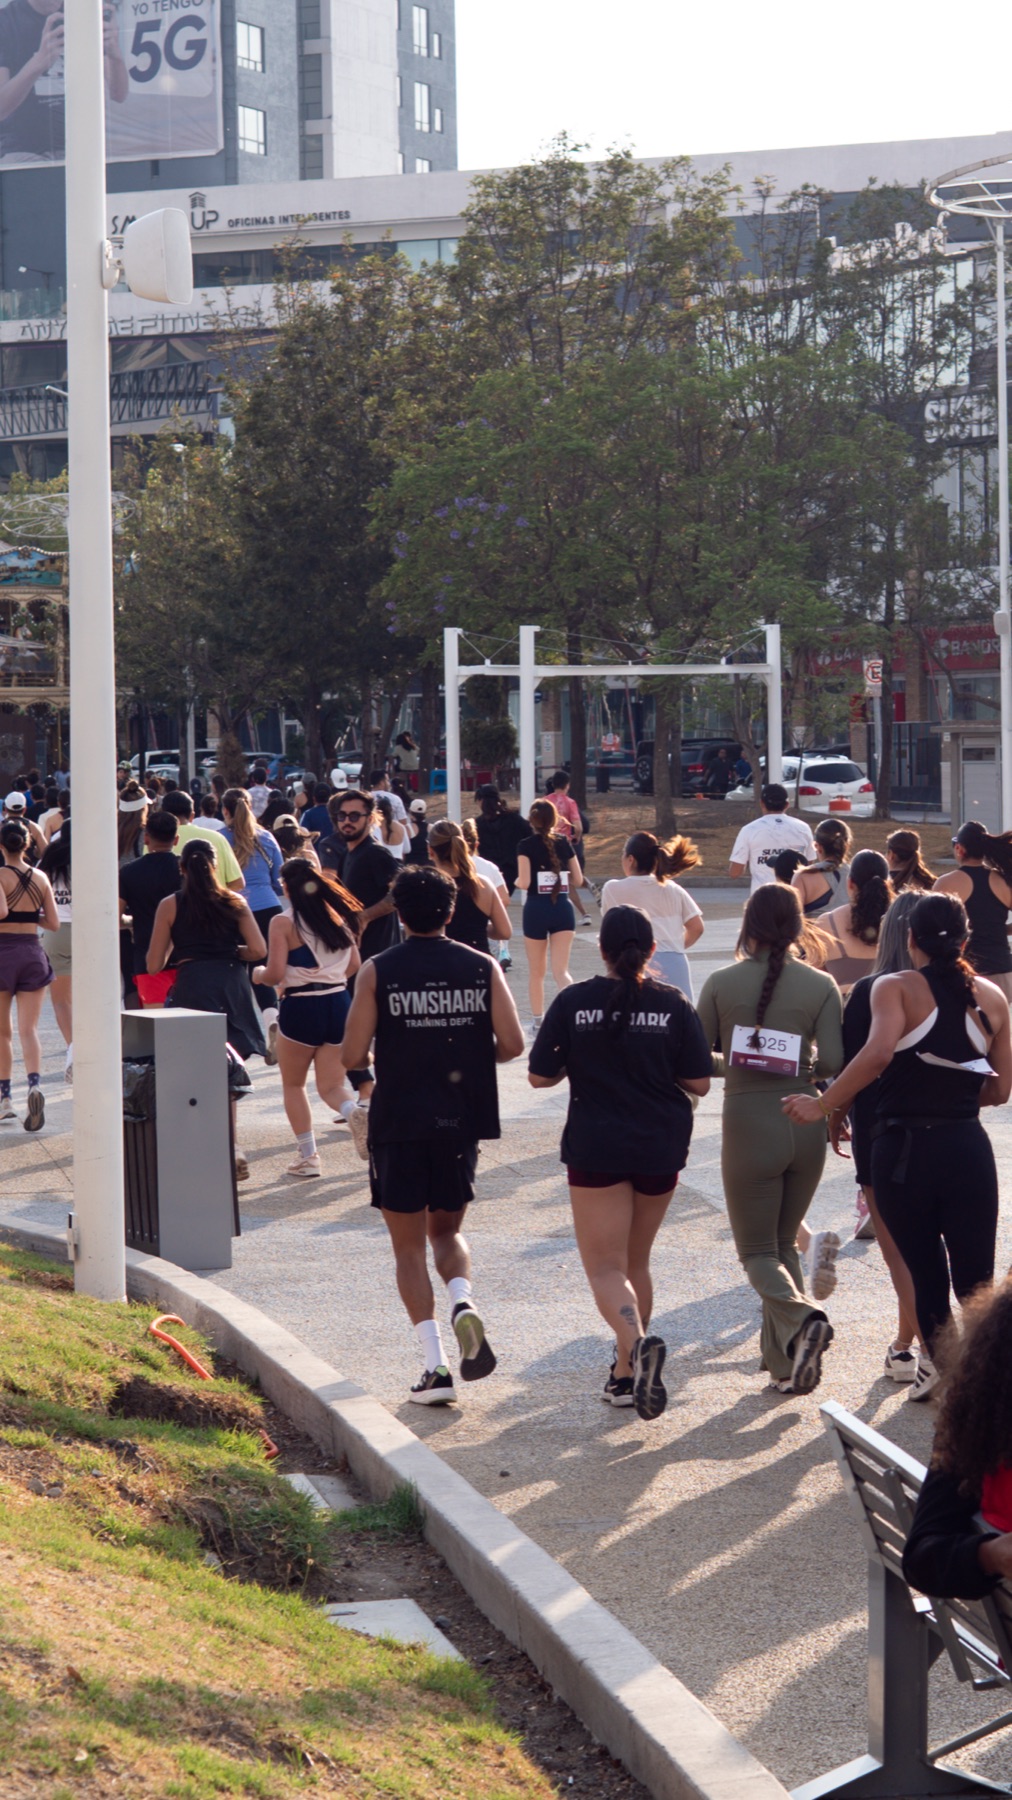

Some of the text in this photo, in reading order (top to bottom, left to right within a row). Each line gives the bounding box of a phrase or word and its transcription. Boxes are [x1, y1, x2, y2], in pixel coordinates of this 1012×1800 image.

[132, 0, 204, 16] YO TENGO
[128, 14, 208, 84] 5G
[191, 210, 219, 230] UP
[227, 215, 275, 228] OFICINAS
[20, 308, 265, 341] ANYE FITNE
[951, 638, 1001, 656] BANOR
[388, 988, 488, 1017] GYMSHARK
[405, 1016, 474, 1028] TRAINING DEPT.
[575, 1009, 672, 1034] GYARK
